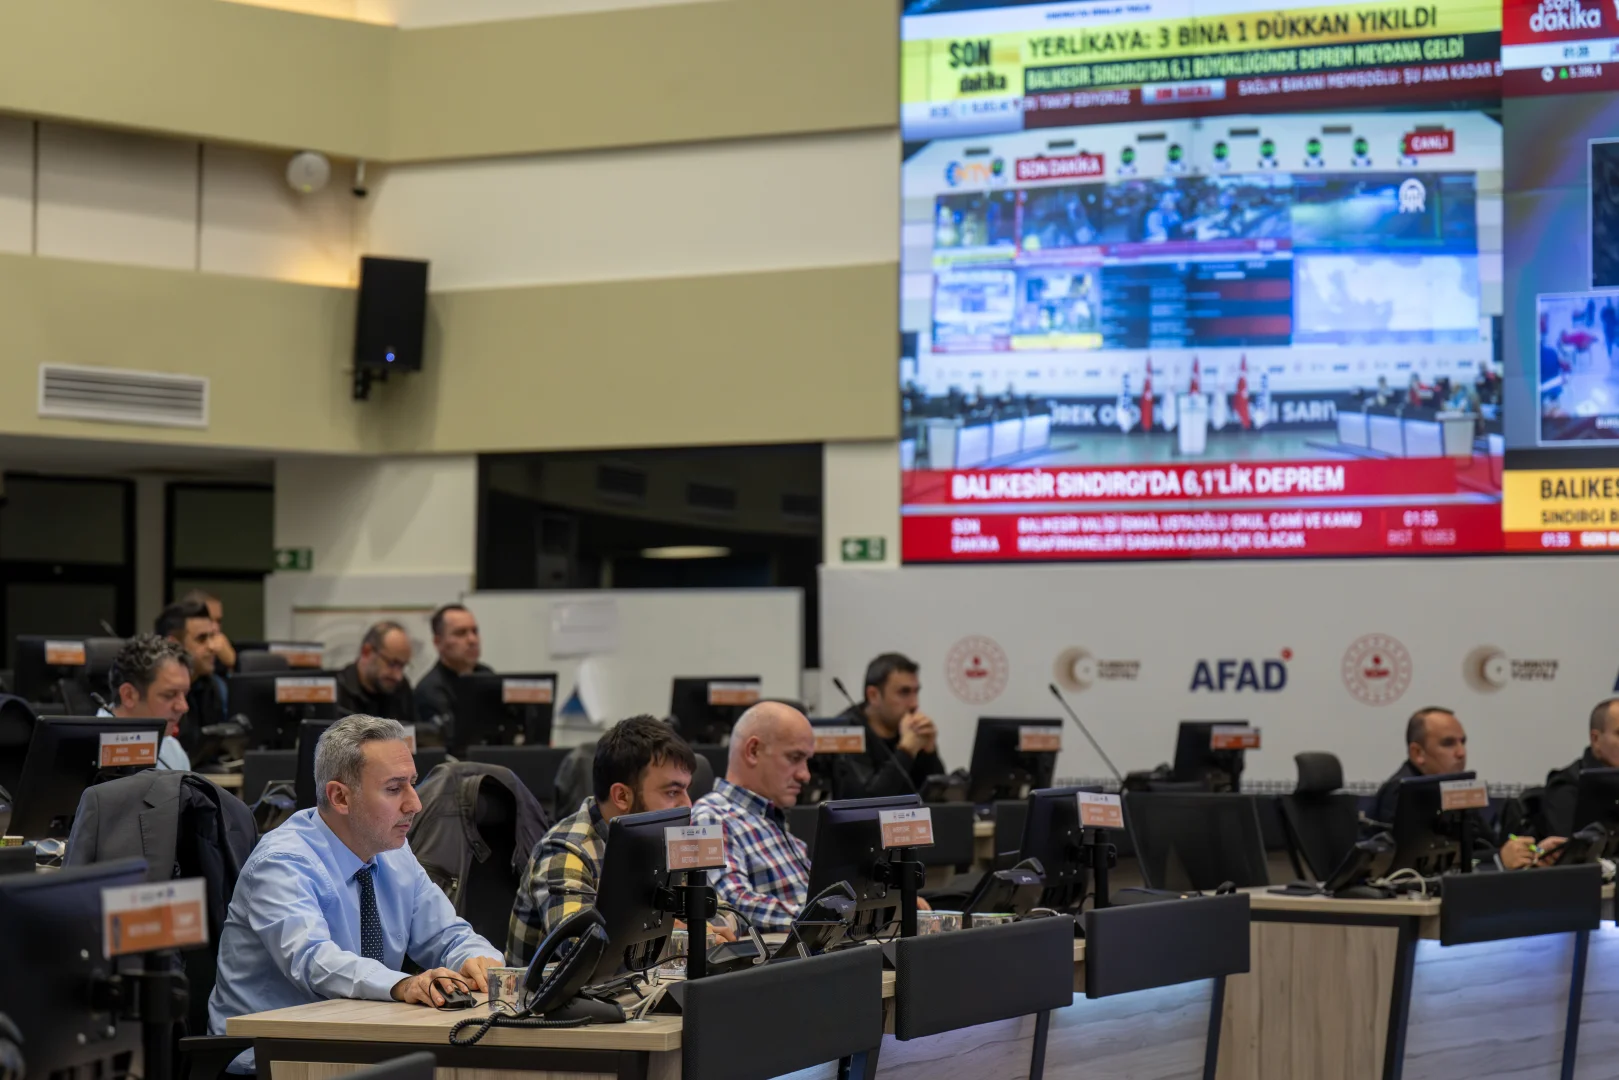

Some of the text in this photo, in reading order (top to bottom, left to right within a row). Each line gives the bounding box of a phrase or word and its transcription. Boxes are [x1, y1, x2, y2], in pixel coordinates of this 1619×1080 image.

[1159, 27, 1169, 48] 3
[1179, 20, 1229, 46] BİNA
[1237, 22, 1248, 41] 1
[1256, 10, 1348, 39] DÜKKAN
[1358, 6, 1436, 32] YIKILDI
[1529, 3, 1601, 33] dakika
[950, 40, 990, 68] SON
[952, 468, 1055, 500] BALIKESİR
[1255, 465, 1345, 493] DEPREM
[1189, 656, 1287, 694] AFAD
